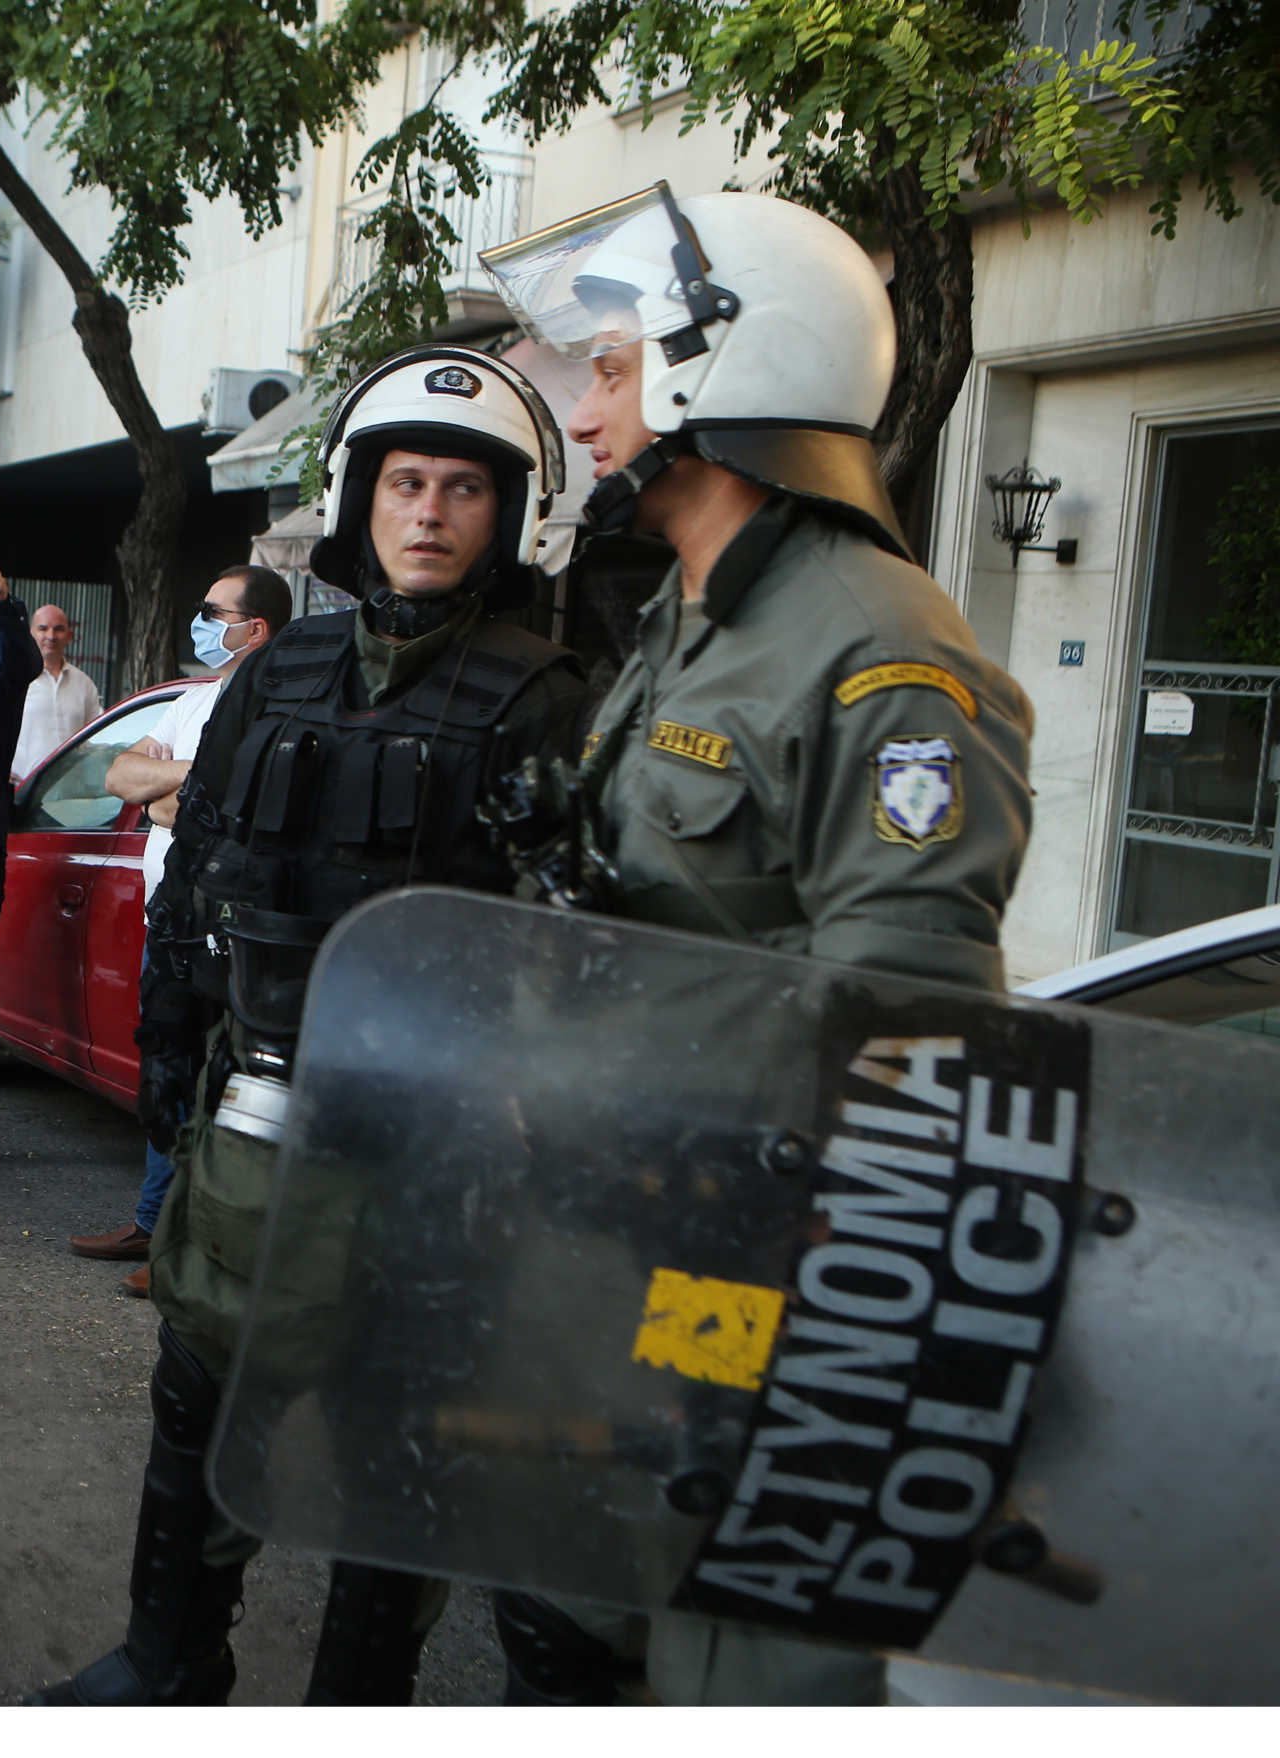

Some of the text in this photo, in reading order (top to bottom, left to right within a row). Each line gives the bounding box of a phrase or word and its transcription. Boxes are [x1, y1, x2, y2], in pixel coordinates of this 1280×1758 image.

[655, 725, 724, 762] POLICE
[697, 1037, 965, 1613] ΑΣΤΥΝΟΜΙΑ
[832, 1076, 1077, 1612] POLICE
